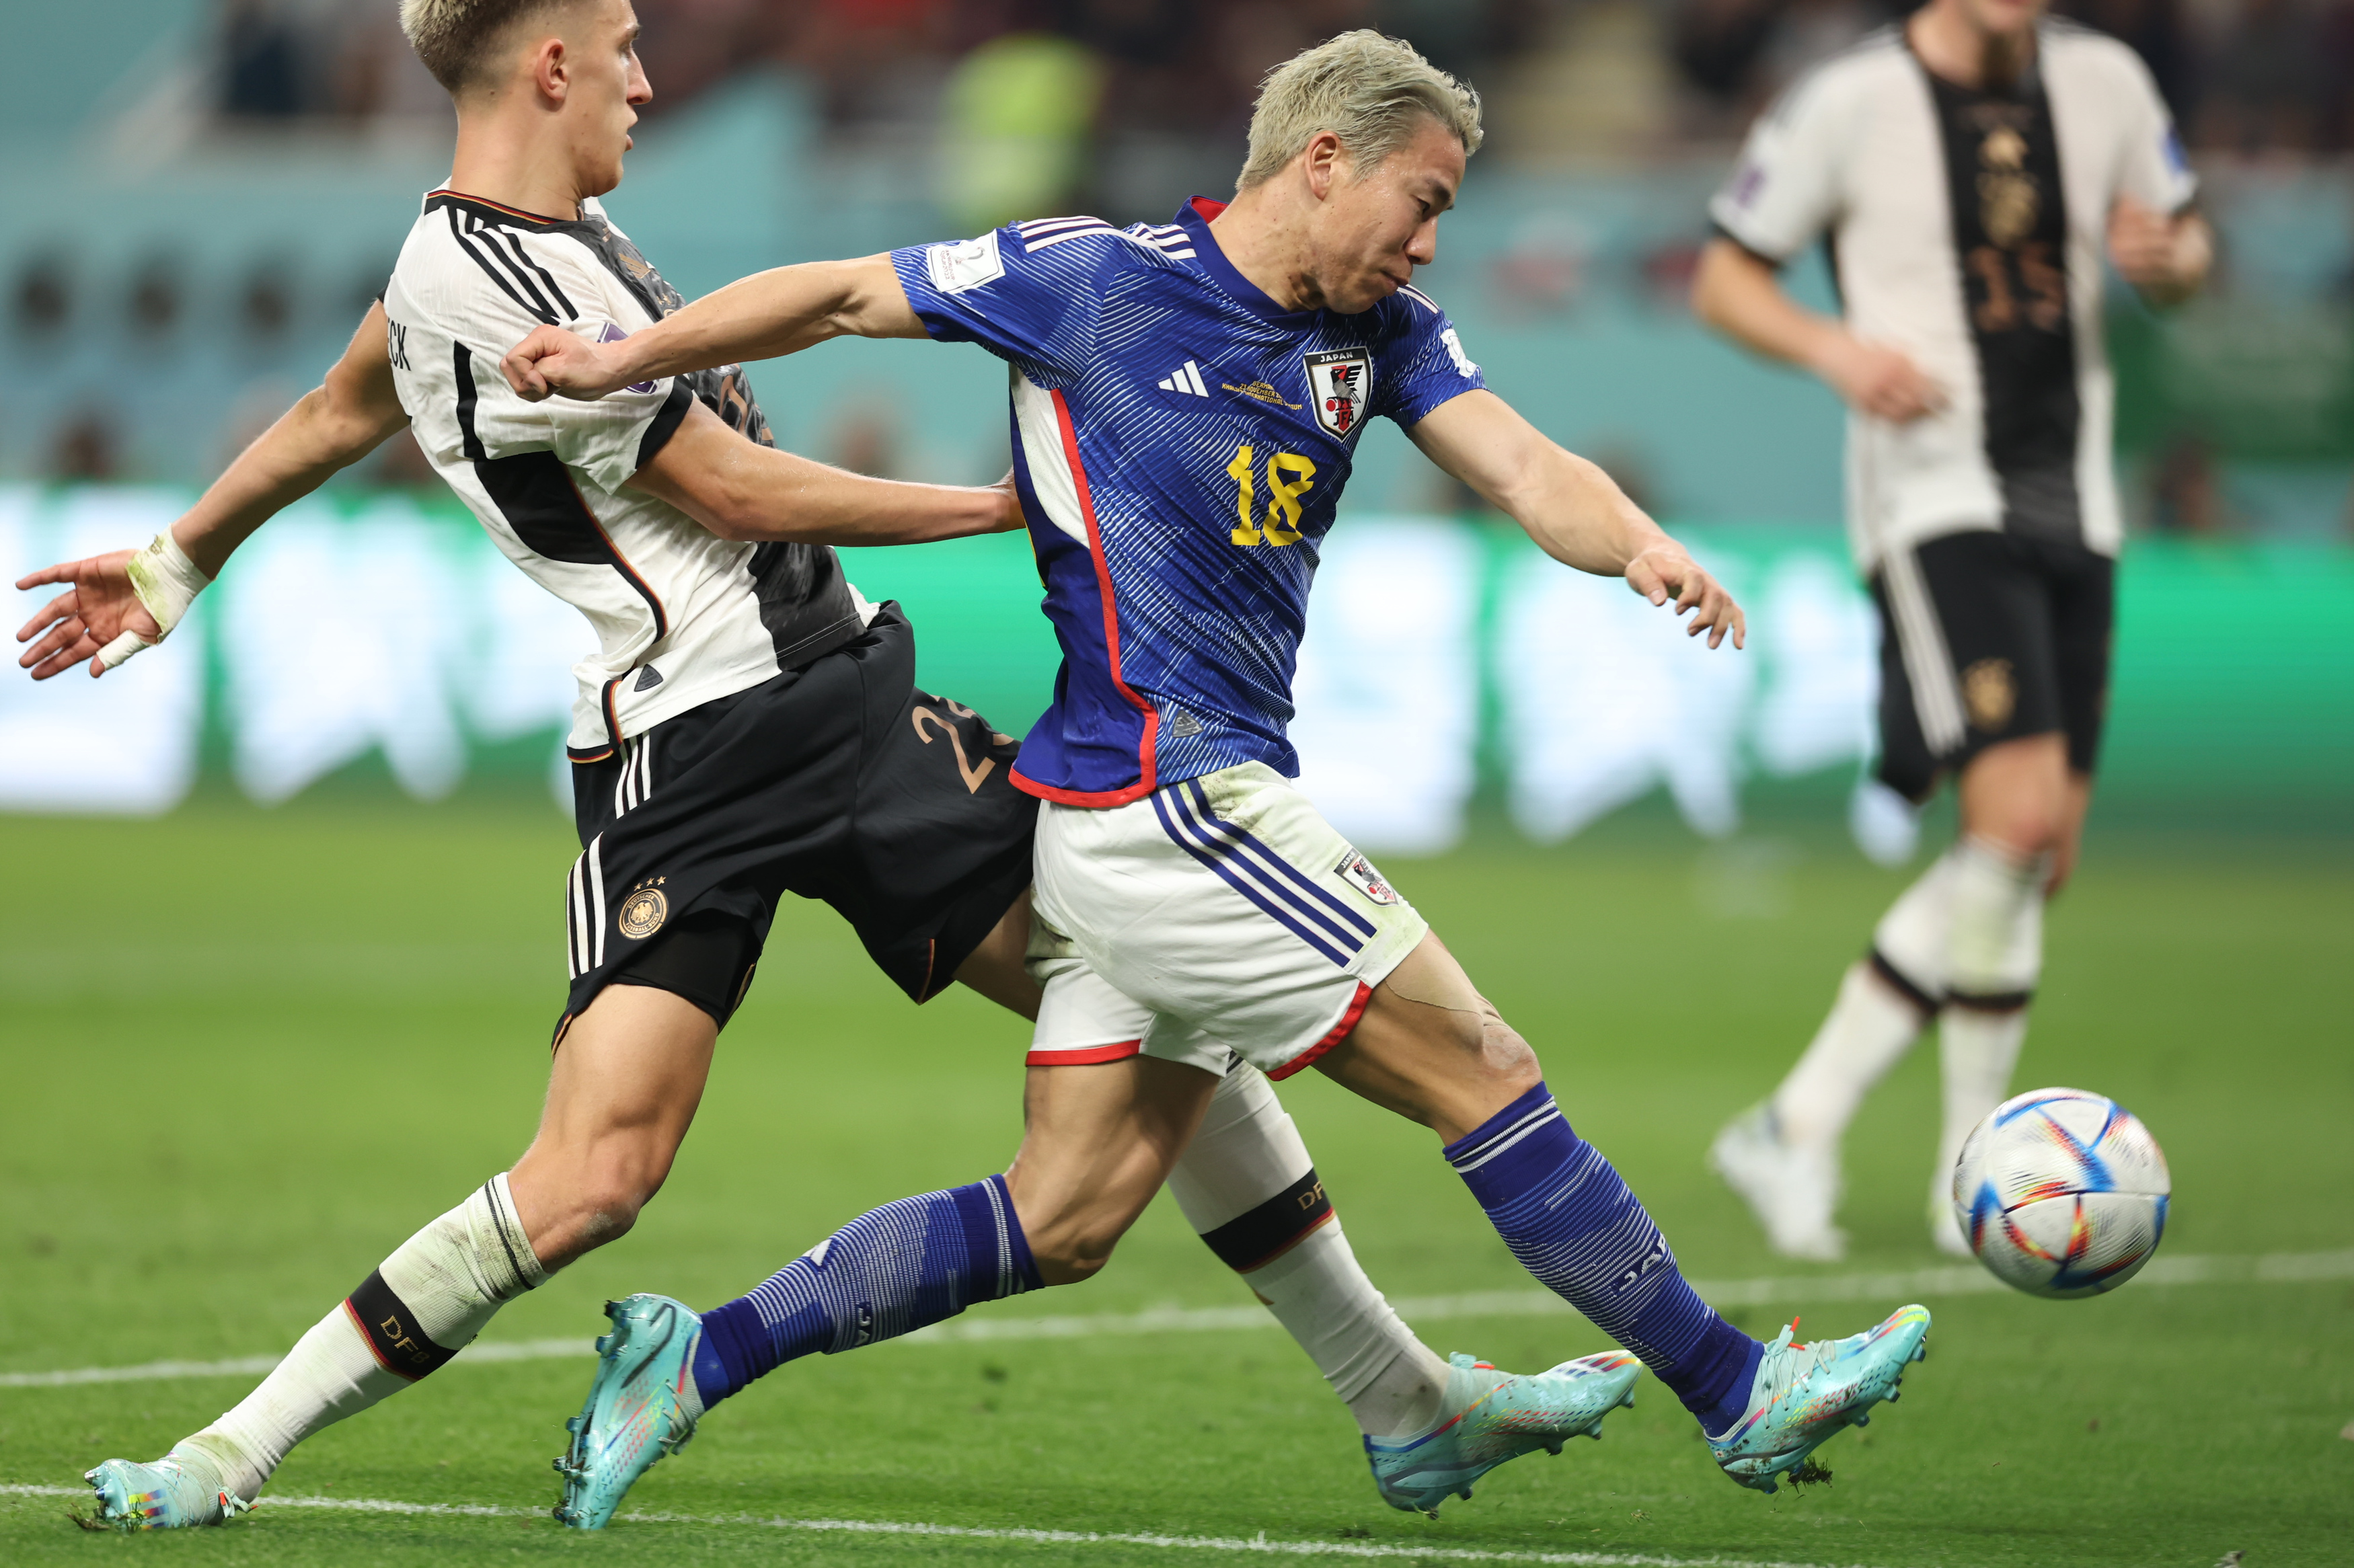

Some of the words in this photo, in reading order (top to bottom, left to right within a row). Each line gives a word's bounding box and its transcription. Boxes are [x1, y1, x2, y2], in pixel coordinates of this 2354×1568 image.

[387, 317, 411, 371] CK
[1320, 351, 1353, 362] JAPAN
[1246, 385, 1275, 397] NOVEMBER
[1333, 410, 1355, 426] JFA
[1226, 446, 1316, 547] 18
[1340, 851, 1356, 869] JAPAN
[380, 1315, 430, 1364] DFB
